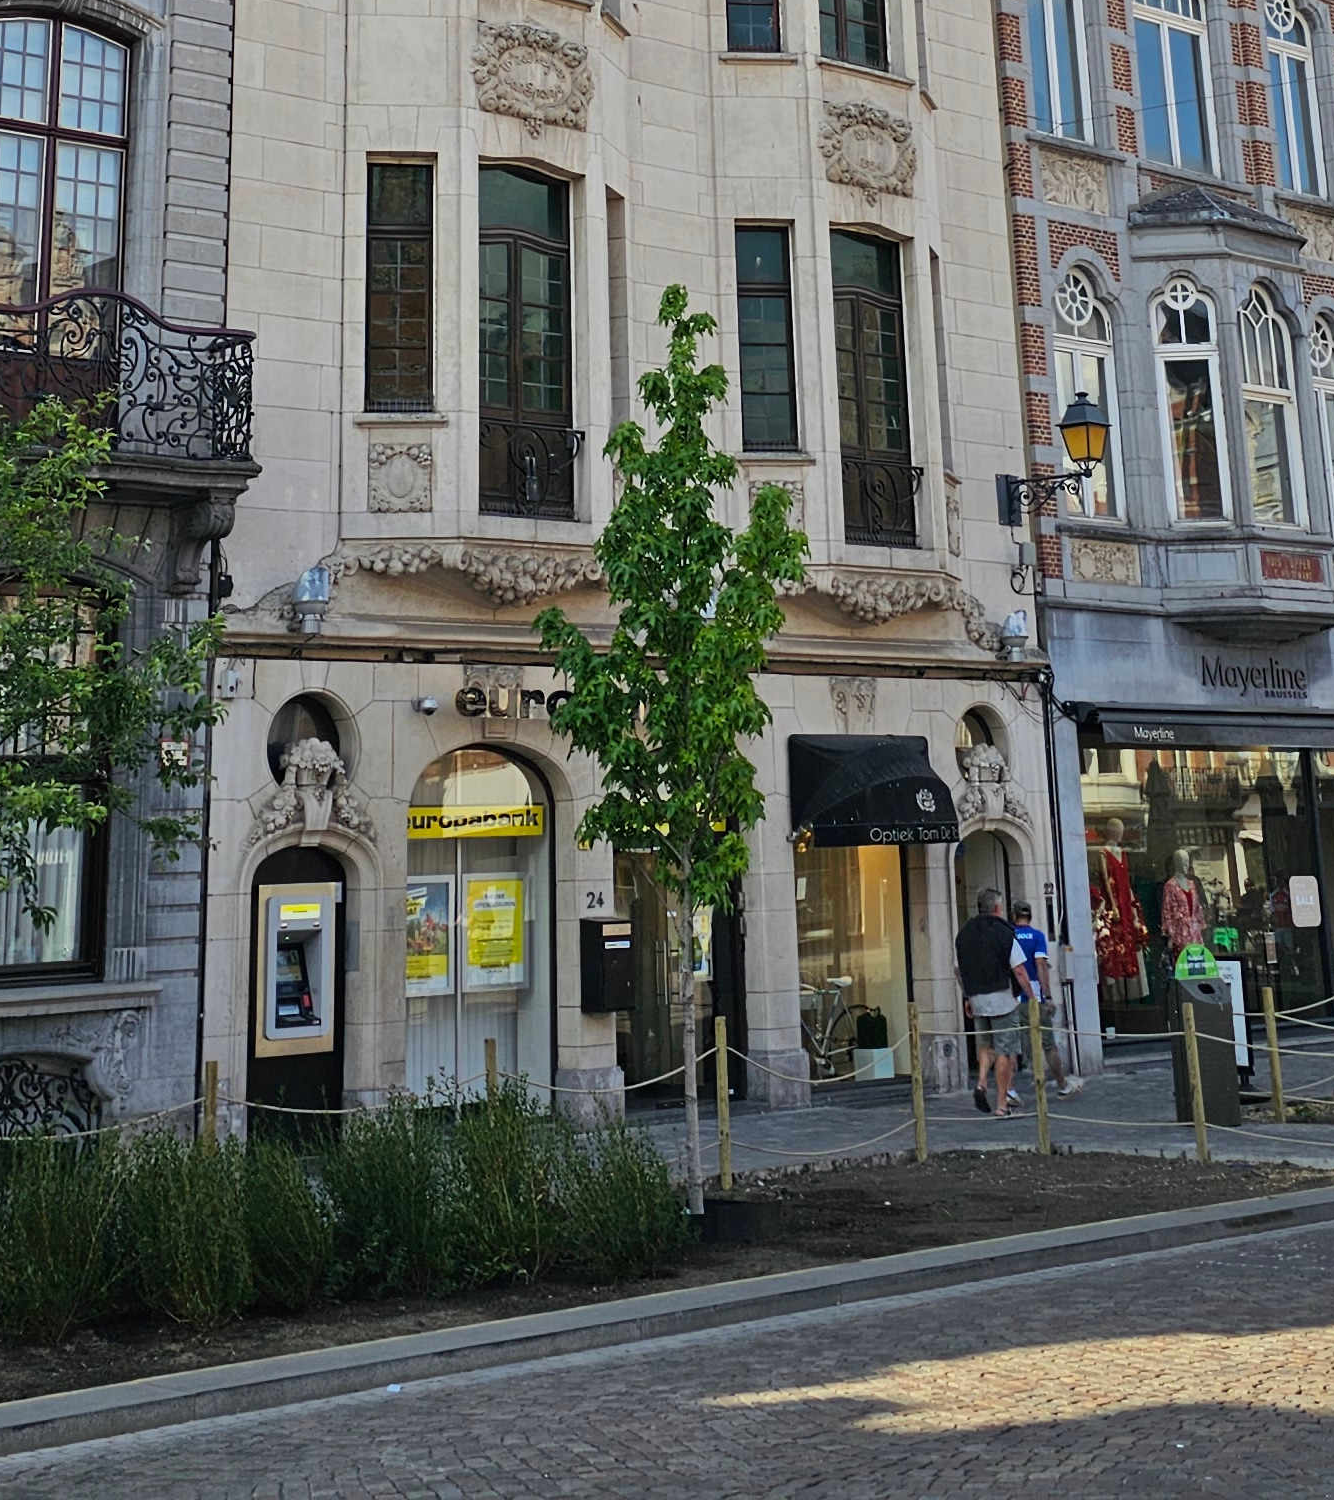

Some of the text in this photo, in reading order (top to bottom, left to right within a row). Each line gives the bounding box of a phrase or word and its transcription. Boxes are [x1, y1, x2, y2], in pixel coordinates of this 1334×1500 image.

[1201, 655, 1307, 697] Mayerline
[1264, 690, 1308, 699] BRUSSELS
[1133, 726, 1175, 741] Mayerline
[407, 809, 539, 830] uropabank
[869, 827, 915, 844] Optiek
[917, 827, 939, 841] Tom
[586, 891, 605, 909] 24
